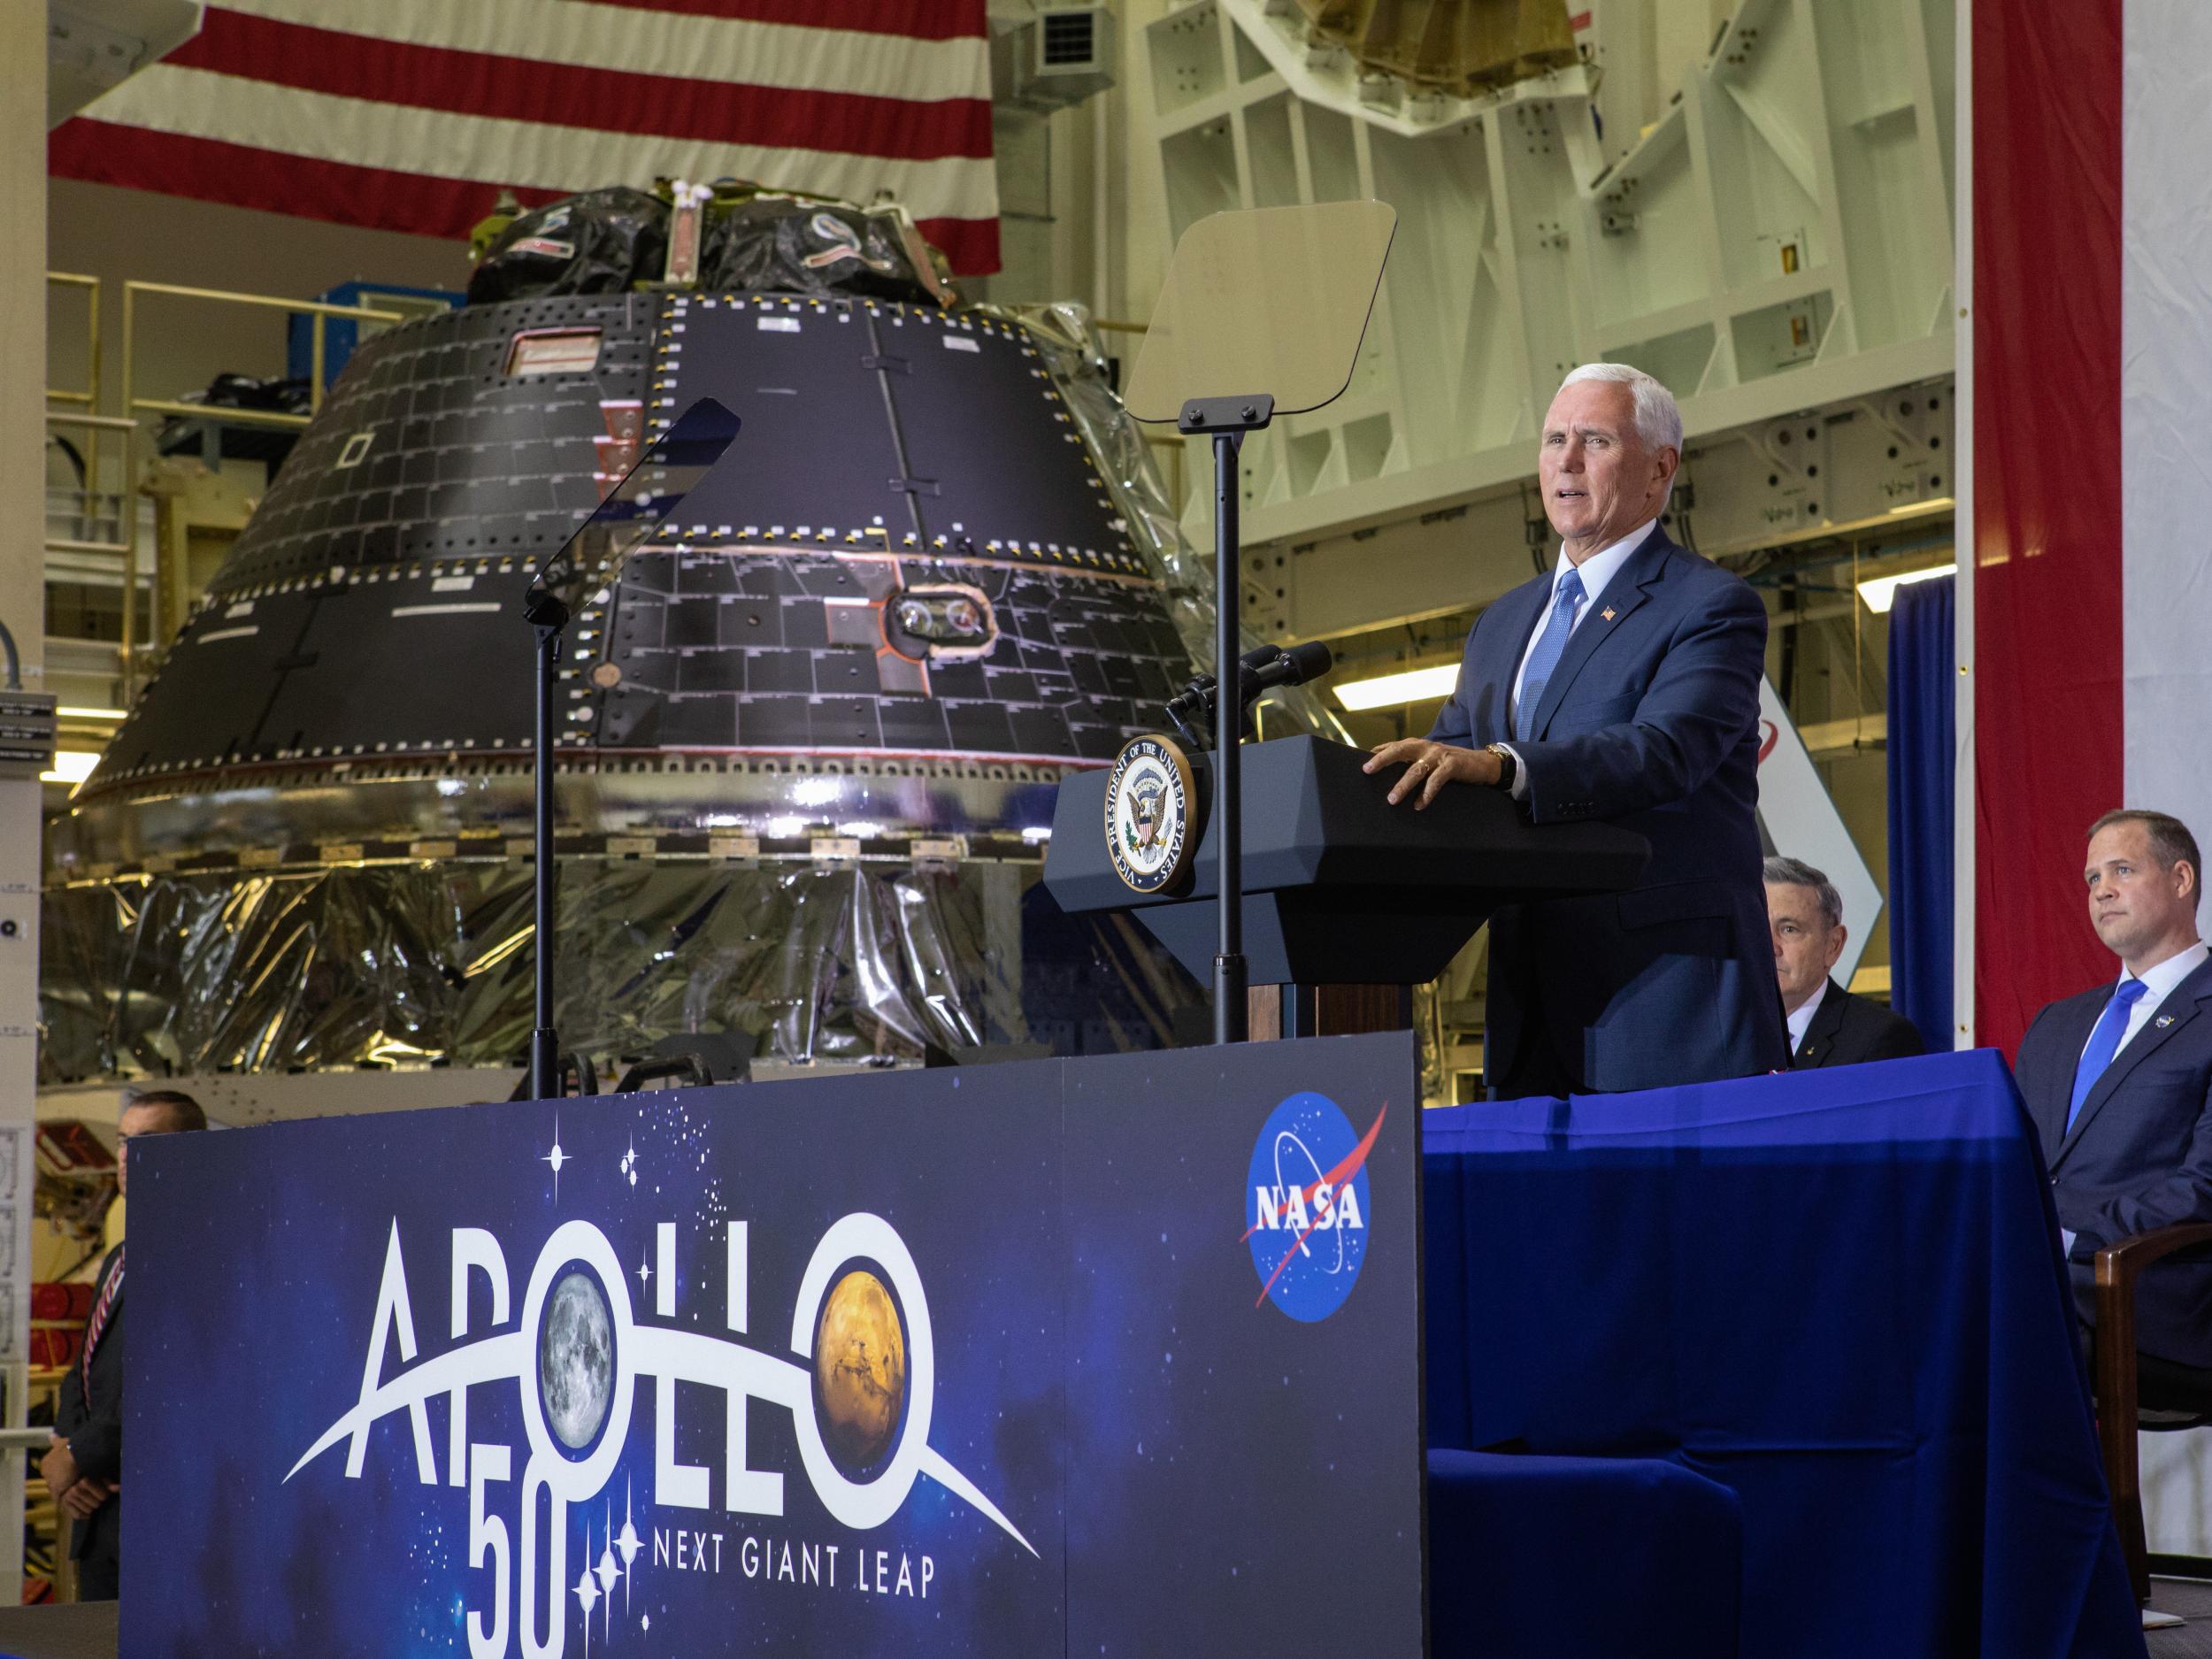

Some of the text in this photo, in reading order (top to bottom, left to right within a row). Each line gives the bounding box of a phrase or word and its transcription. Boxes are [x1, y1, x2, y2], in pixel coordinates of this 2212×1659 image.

[1108, 742, 1185, 885] VICE PRESIDENT OF THE UNITED STATES
[1256, 1183, 1363, 1231] NASA
[343, 1211, 936, 1530] APOLLO
[466, 1443, 567, 1659] 50
[654, 1525, 934, 1599] NEXT GIANT LEAP
